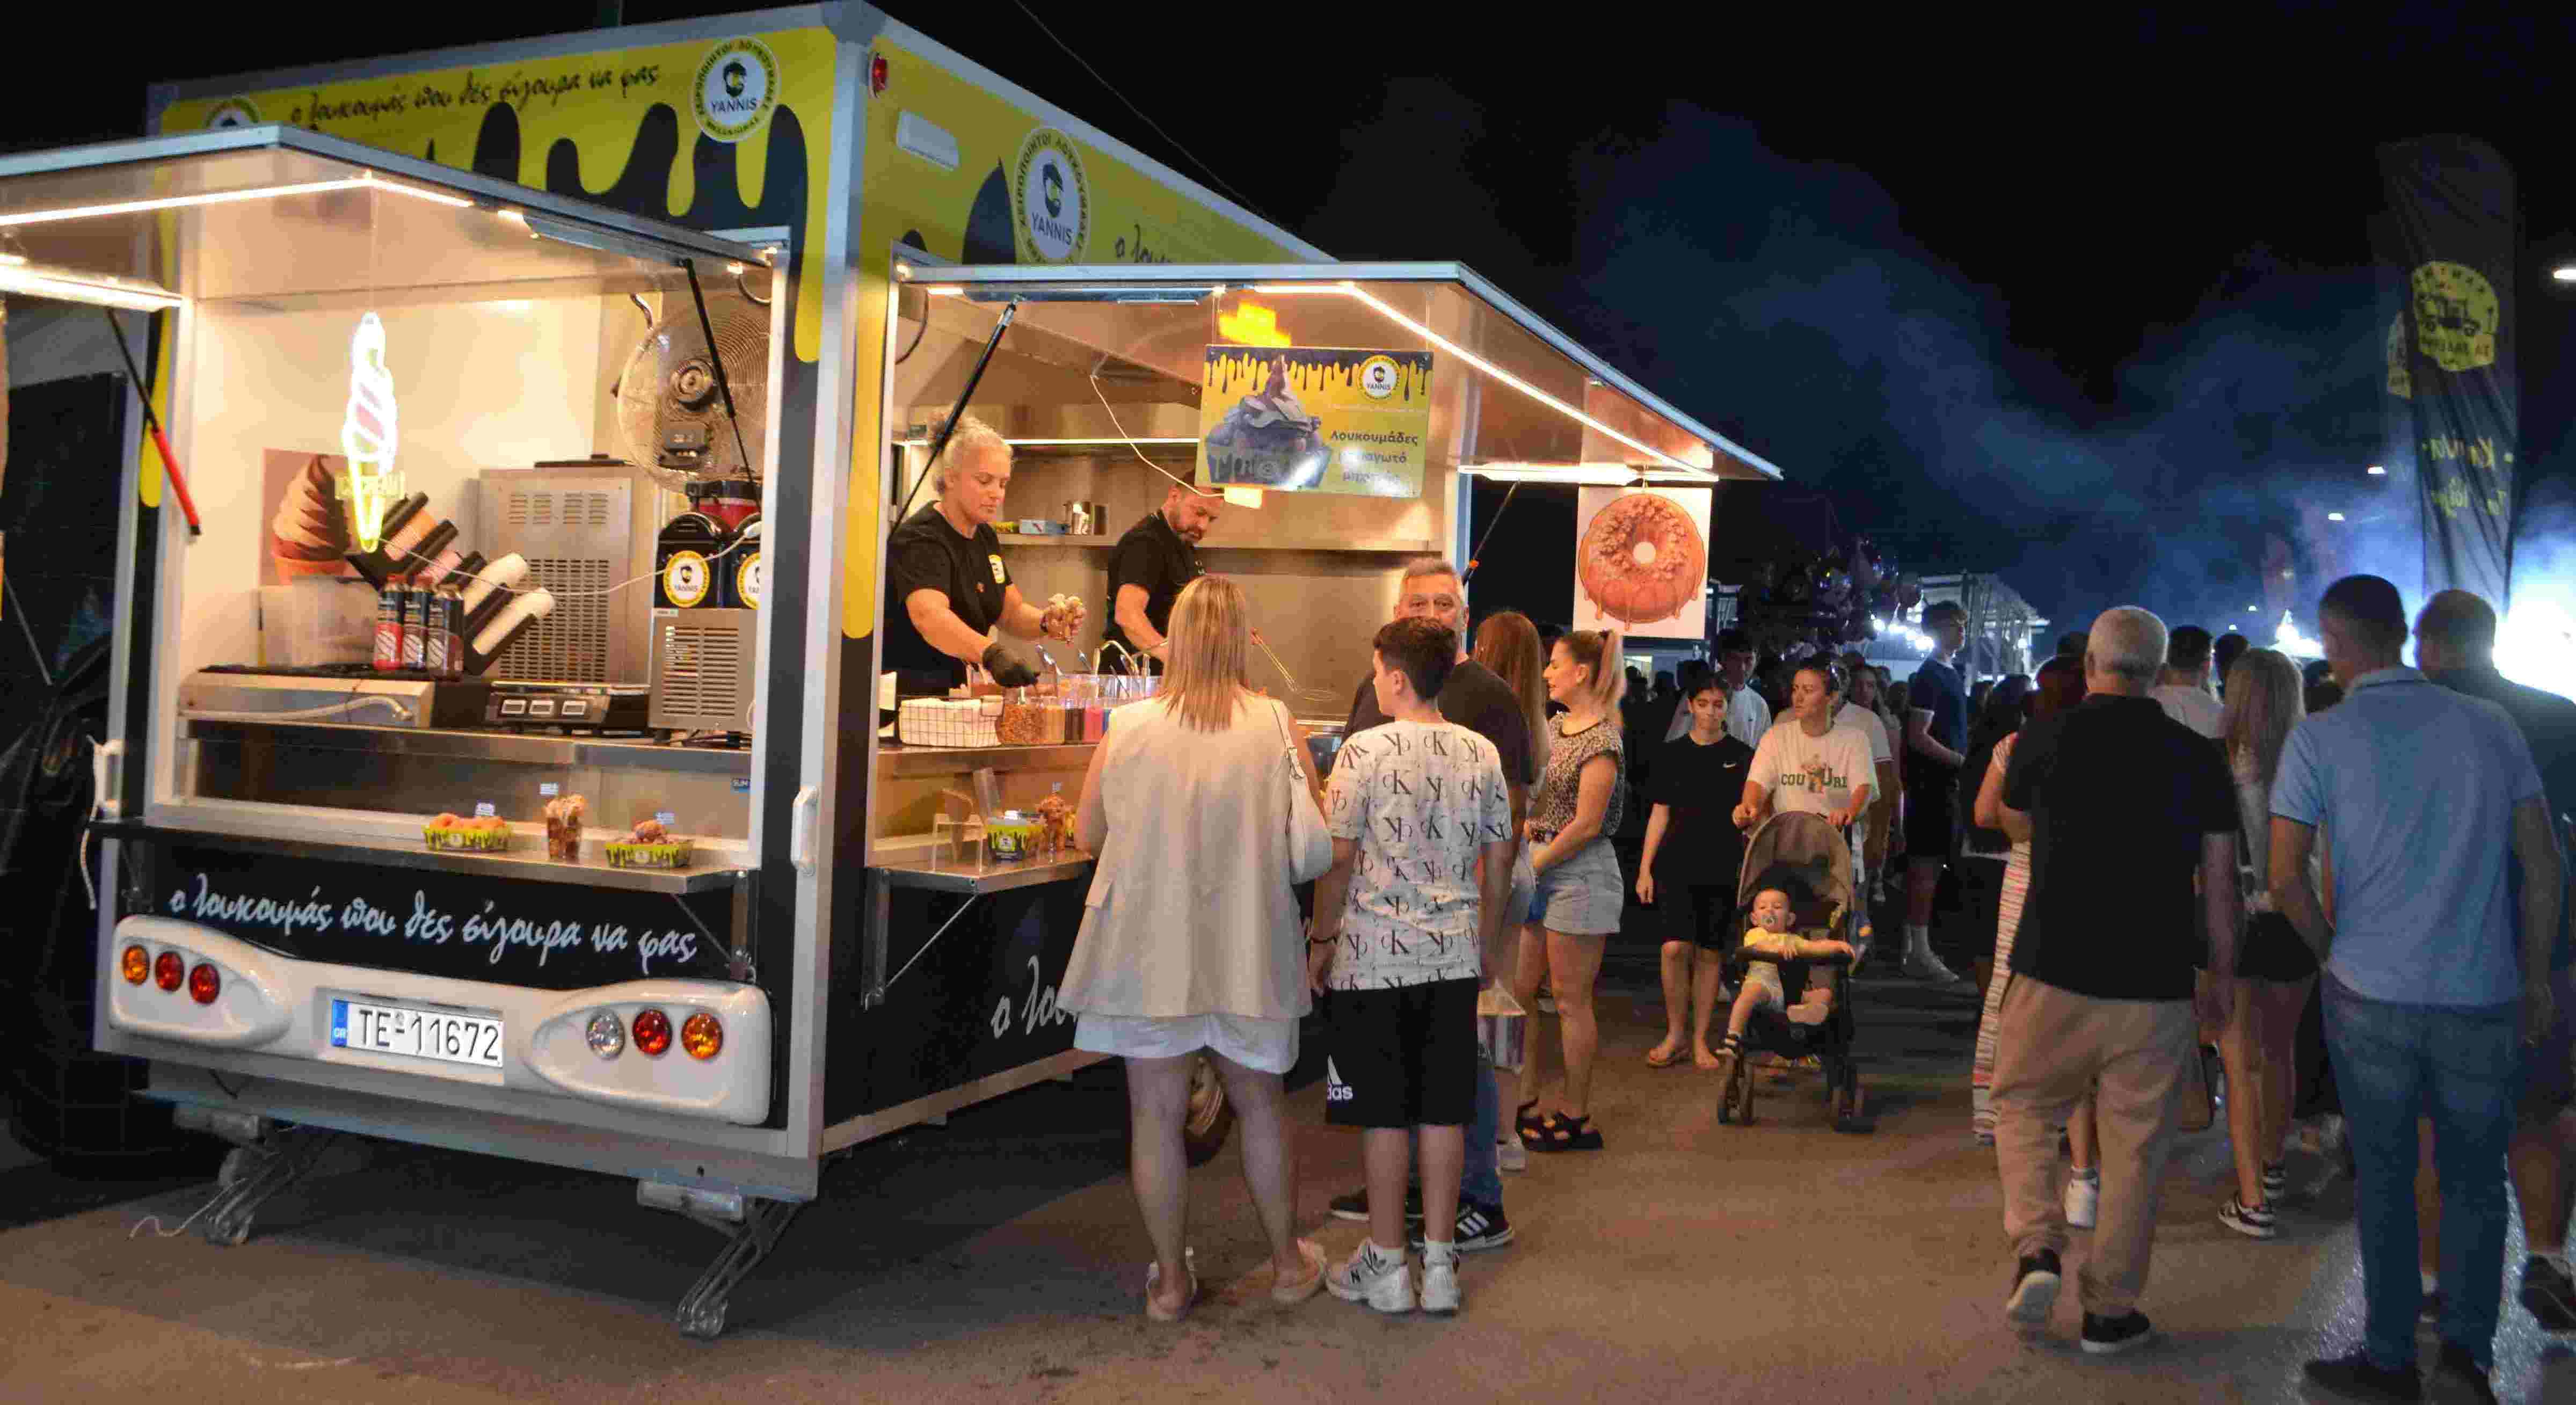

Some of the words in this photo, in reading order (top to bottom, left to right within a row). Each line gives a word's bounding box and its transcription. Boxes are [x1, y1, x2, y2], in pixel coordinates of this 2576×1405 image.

[711, 98, 757, 113] YANNIS
[1031, 212, 1073, 245] YANNIS
[1330, 430, 1418, 447] Λουκουμάδες
[170, 889, 185, 912] ο
[193, 872, 333, 936] λουκουμάς
[340, 897, 397, 935] που
[462, 900, 583, 967] σίγουρα
[591, 923, 628, 952] να
[638, 929, 697, 975] φας
[991, 994, 1012, 1039] ο
